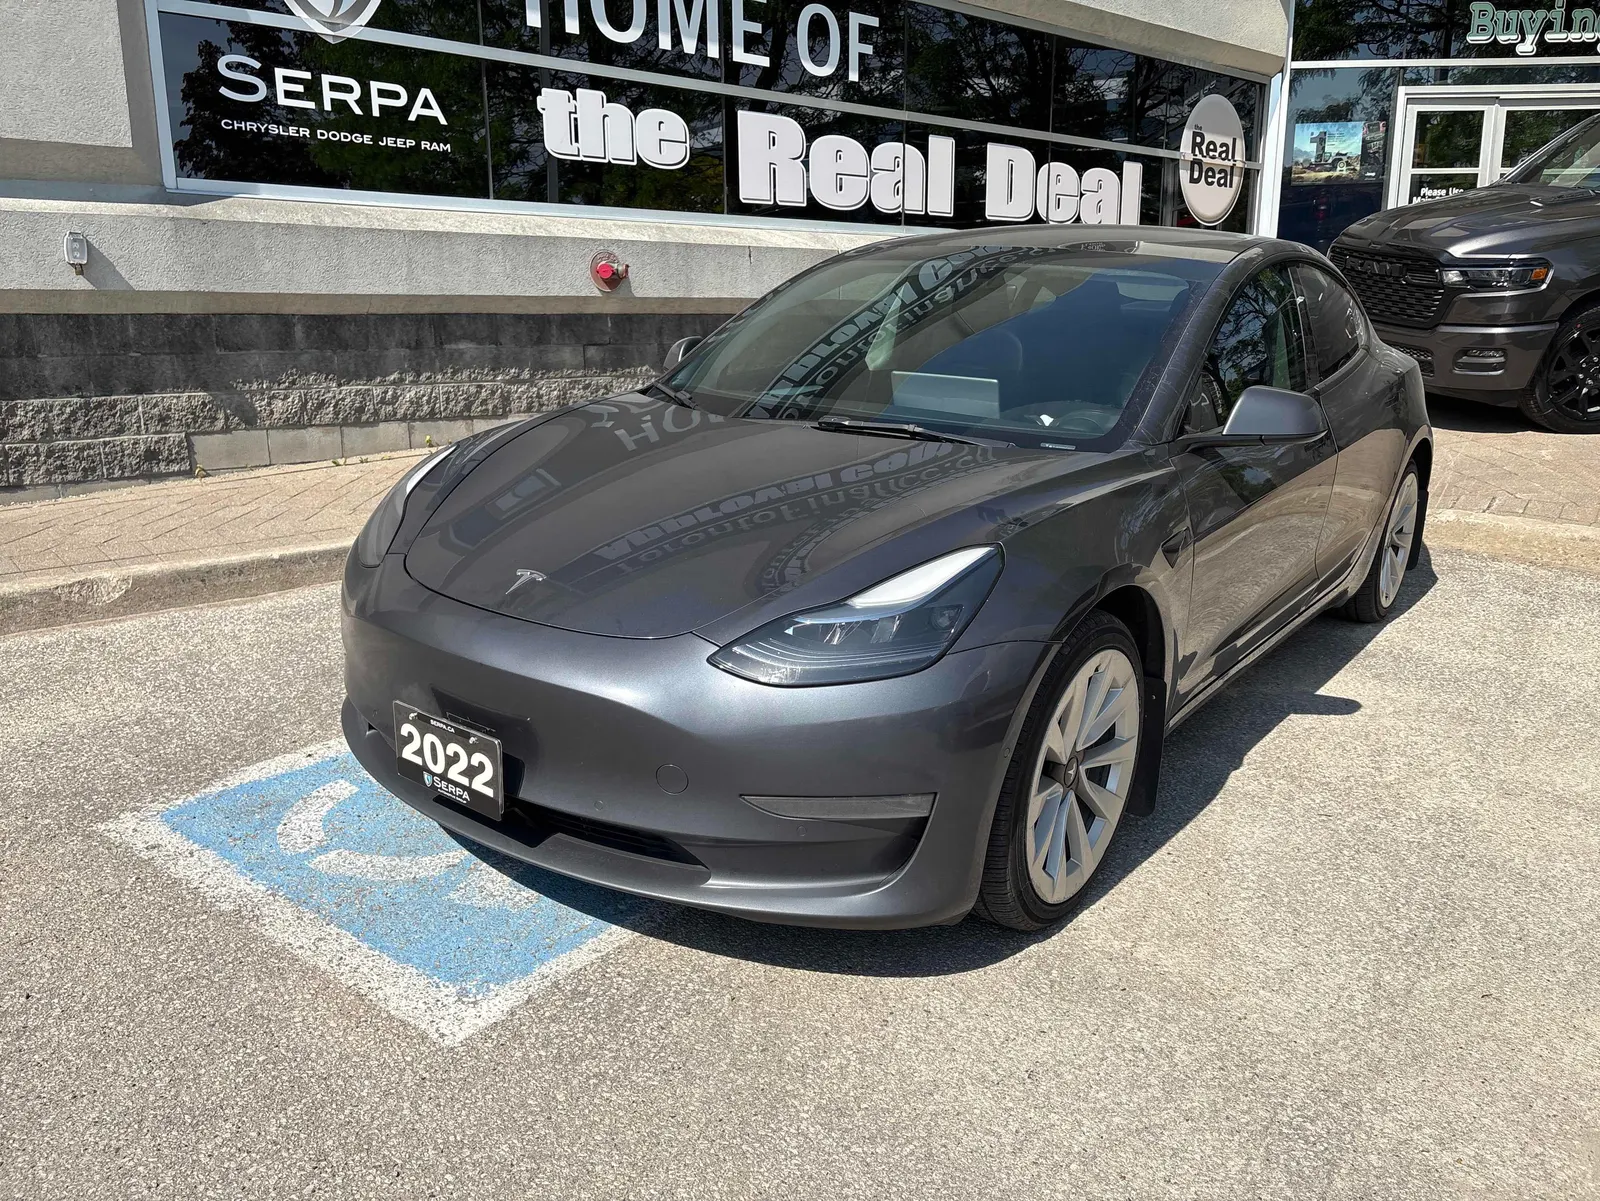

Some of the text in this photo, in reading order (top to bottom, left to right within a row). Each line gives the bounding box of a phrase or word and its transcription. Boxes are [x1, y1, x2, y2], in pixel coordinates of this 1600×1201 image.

[796, 3, 880, 83] OF
[1466, 0, 1600, 55] Buyin
[216, 54, 449, 126] SERPA
[220, 119, 451, 153] CHRYSLER DODGE JEEP RAM
[1190, 130, 1237, 162] Real
[537, 88, 1143, 226] the Real Deal
[1188, 158, 1237, 189] Deal
[1420, 187, 1447, 197] Please
[430, 719, 455, 733] SERPA.CA
[400, 722, 494, 798] 2022
[433, 776, 470, 801] SERPA
